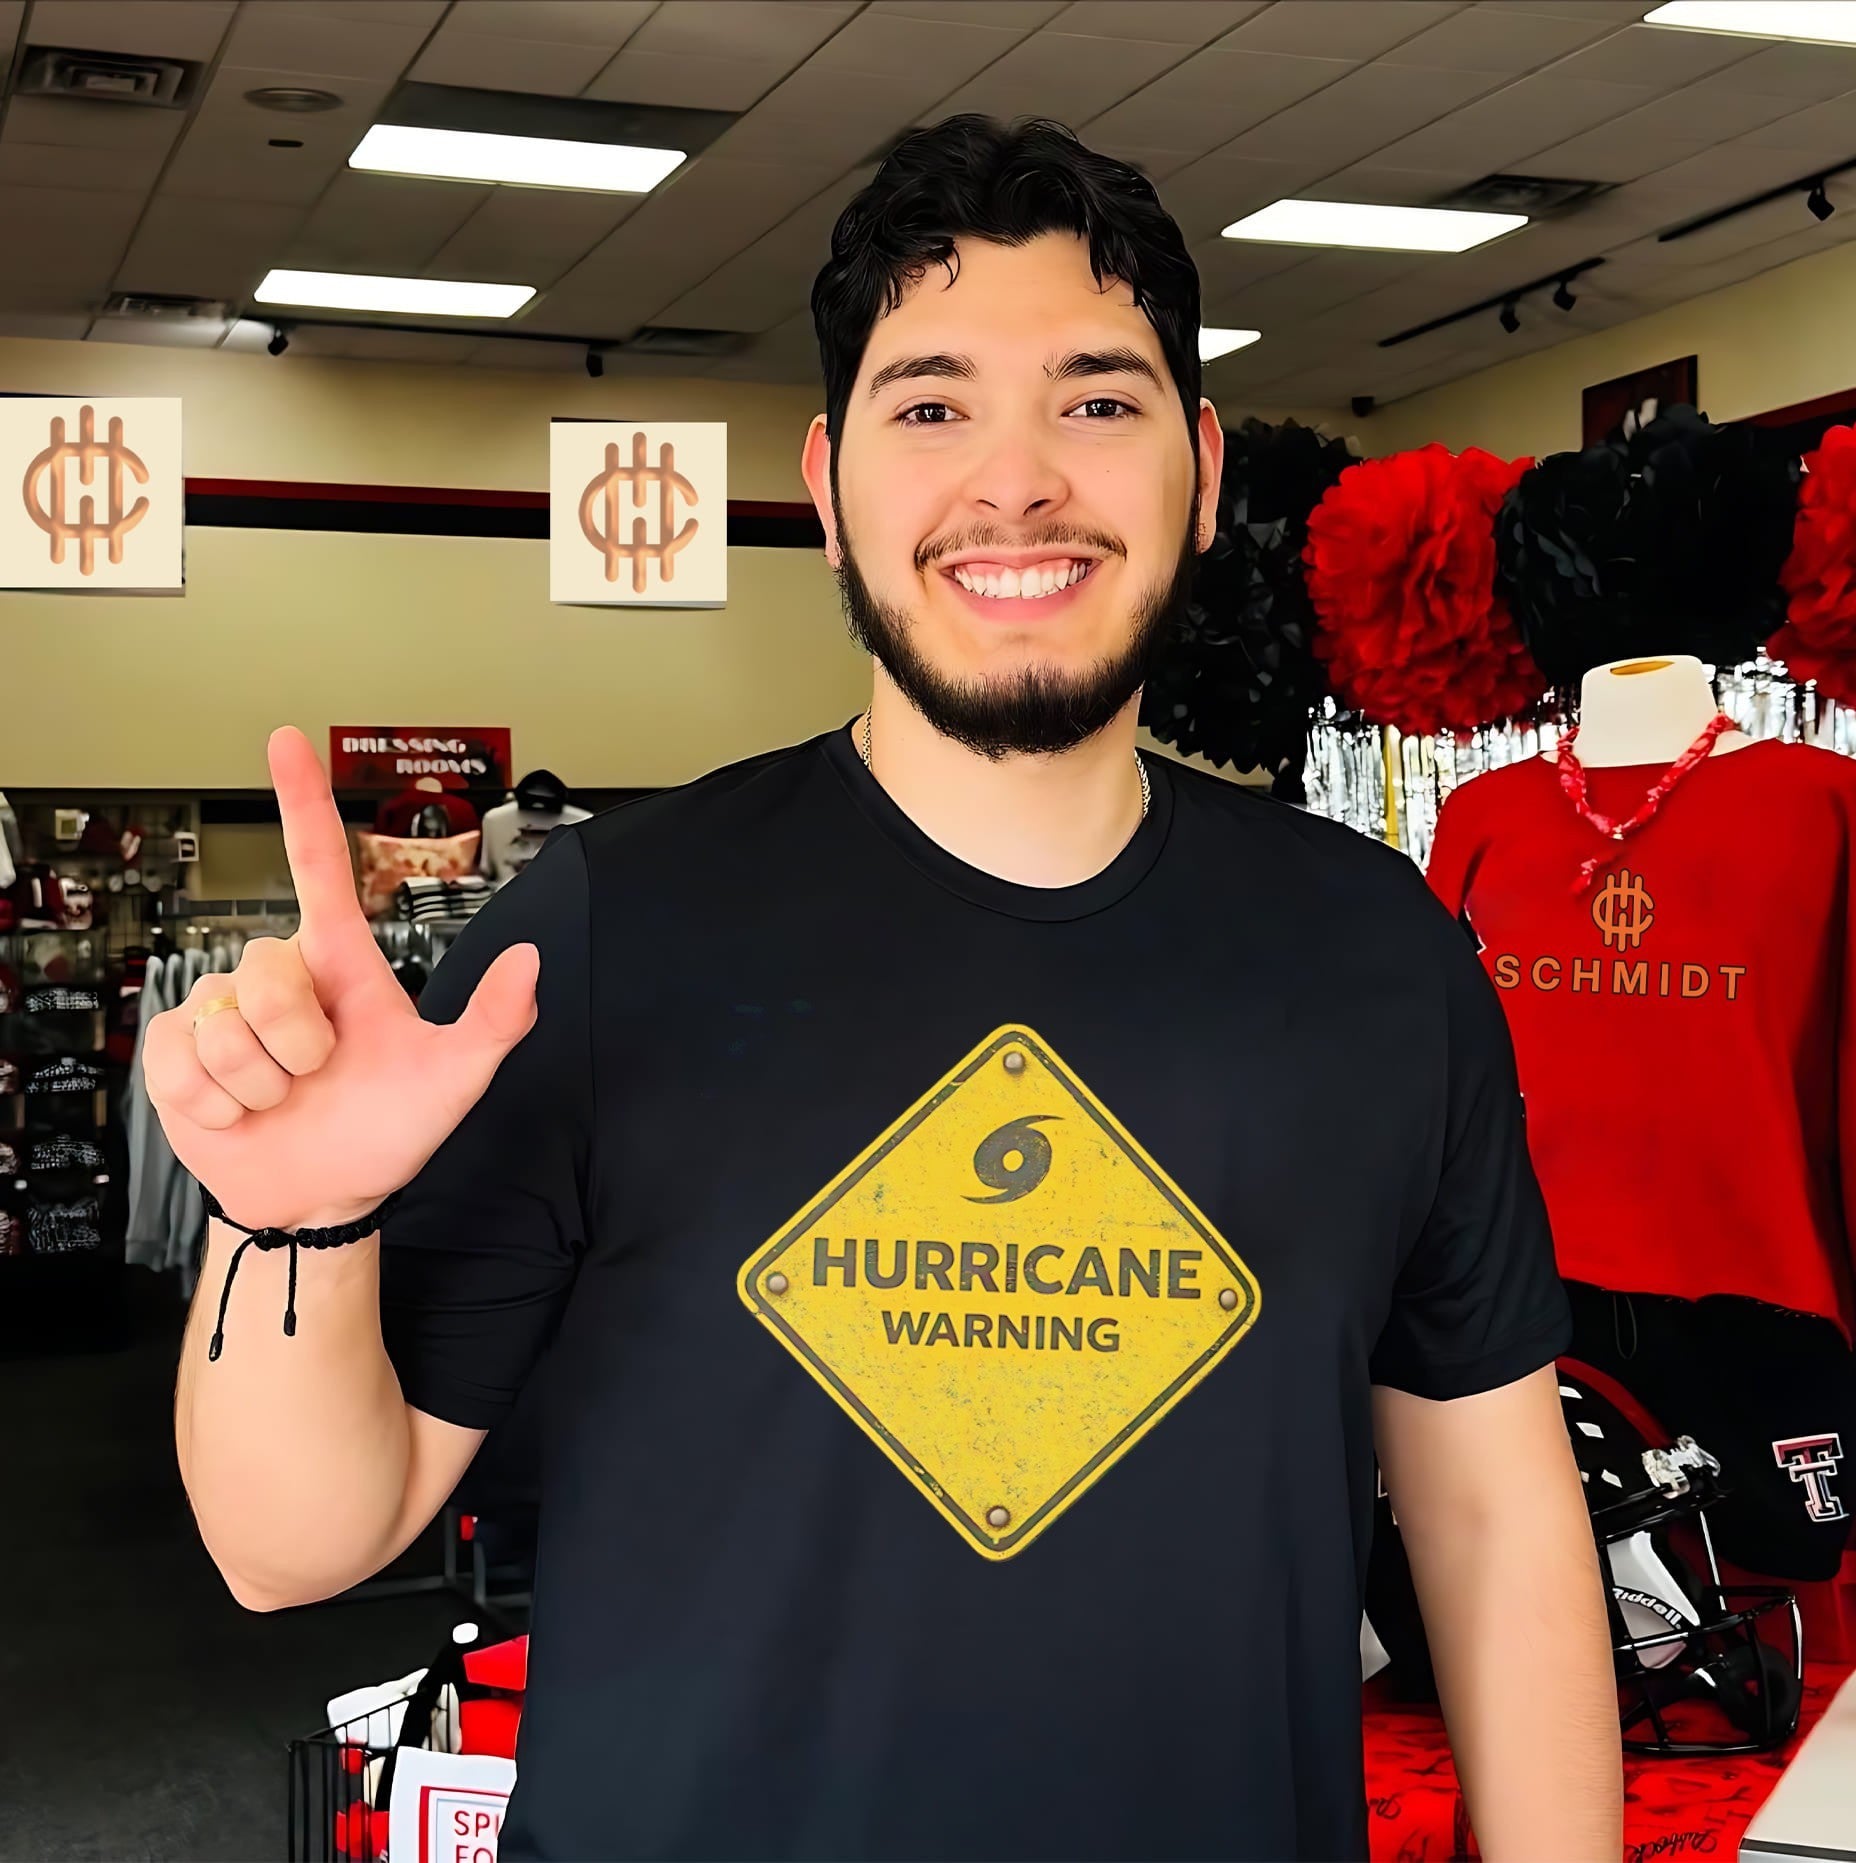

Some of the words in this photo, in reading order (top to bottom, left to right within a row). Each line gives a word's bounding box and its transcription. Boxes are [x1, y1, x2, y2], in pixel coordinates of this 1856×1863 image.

[342, 737, 467, 754] DRESSING
[396, 758, 487, 775] ROOMS
[1494, 953, 1747, 1000] SCHMIDT
[812, 1237, 1202, 1299] HURRICANE
[882, 1310, 1120, 1353] WARNING
